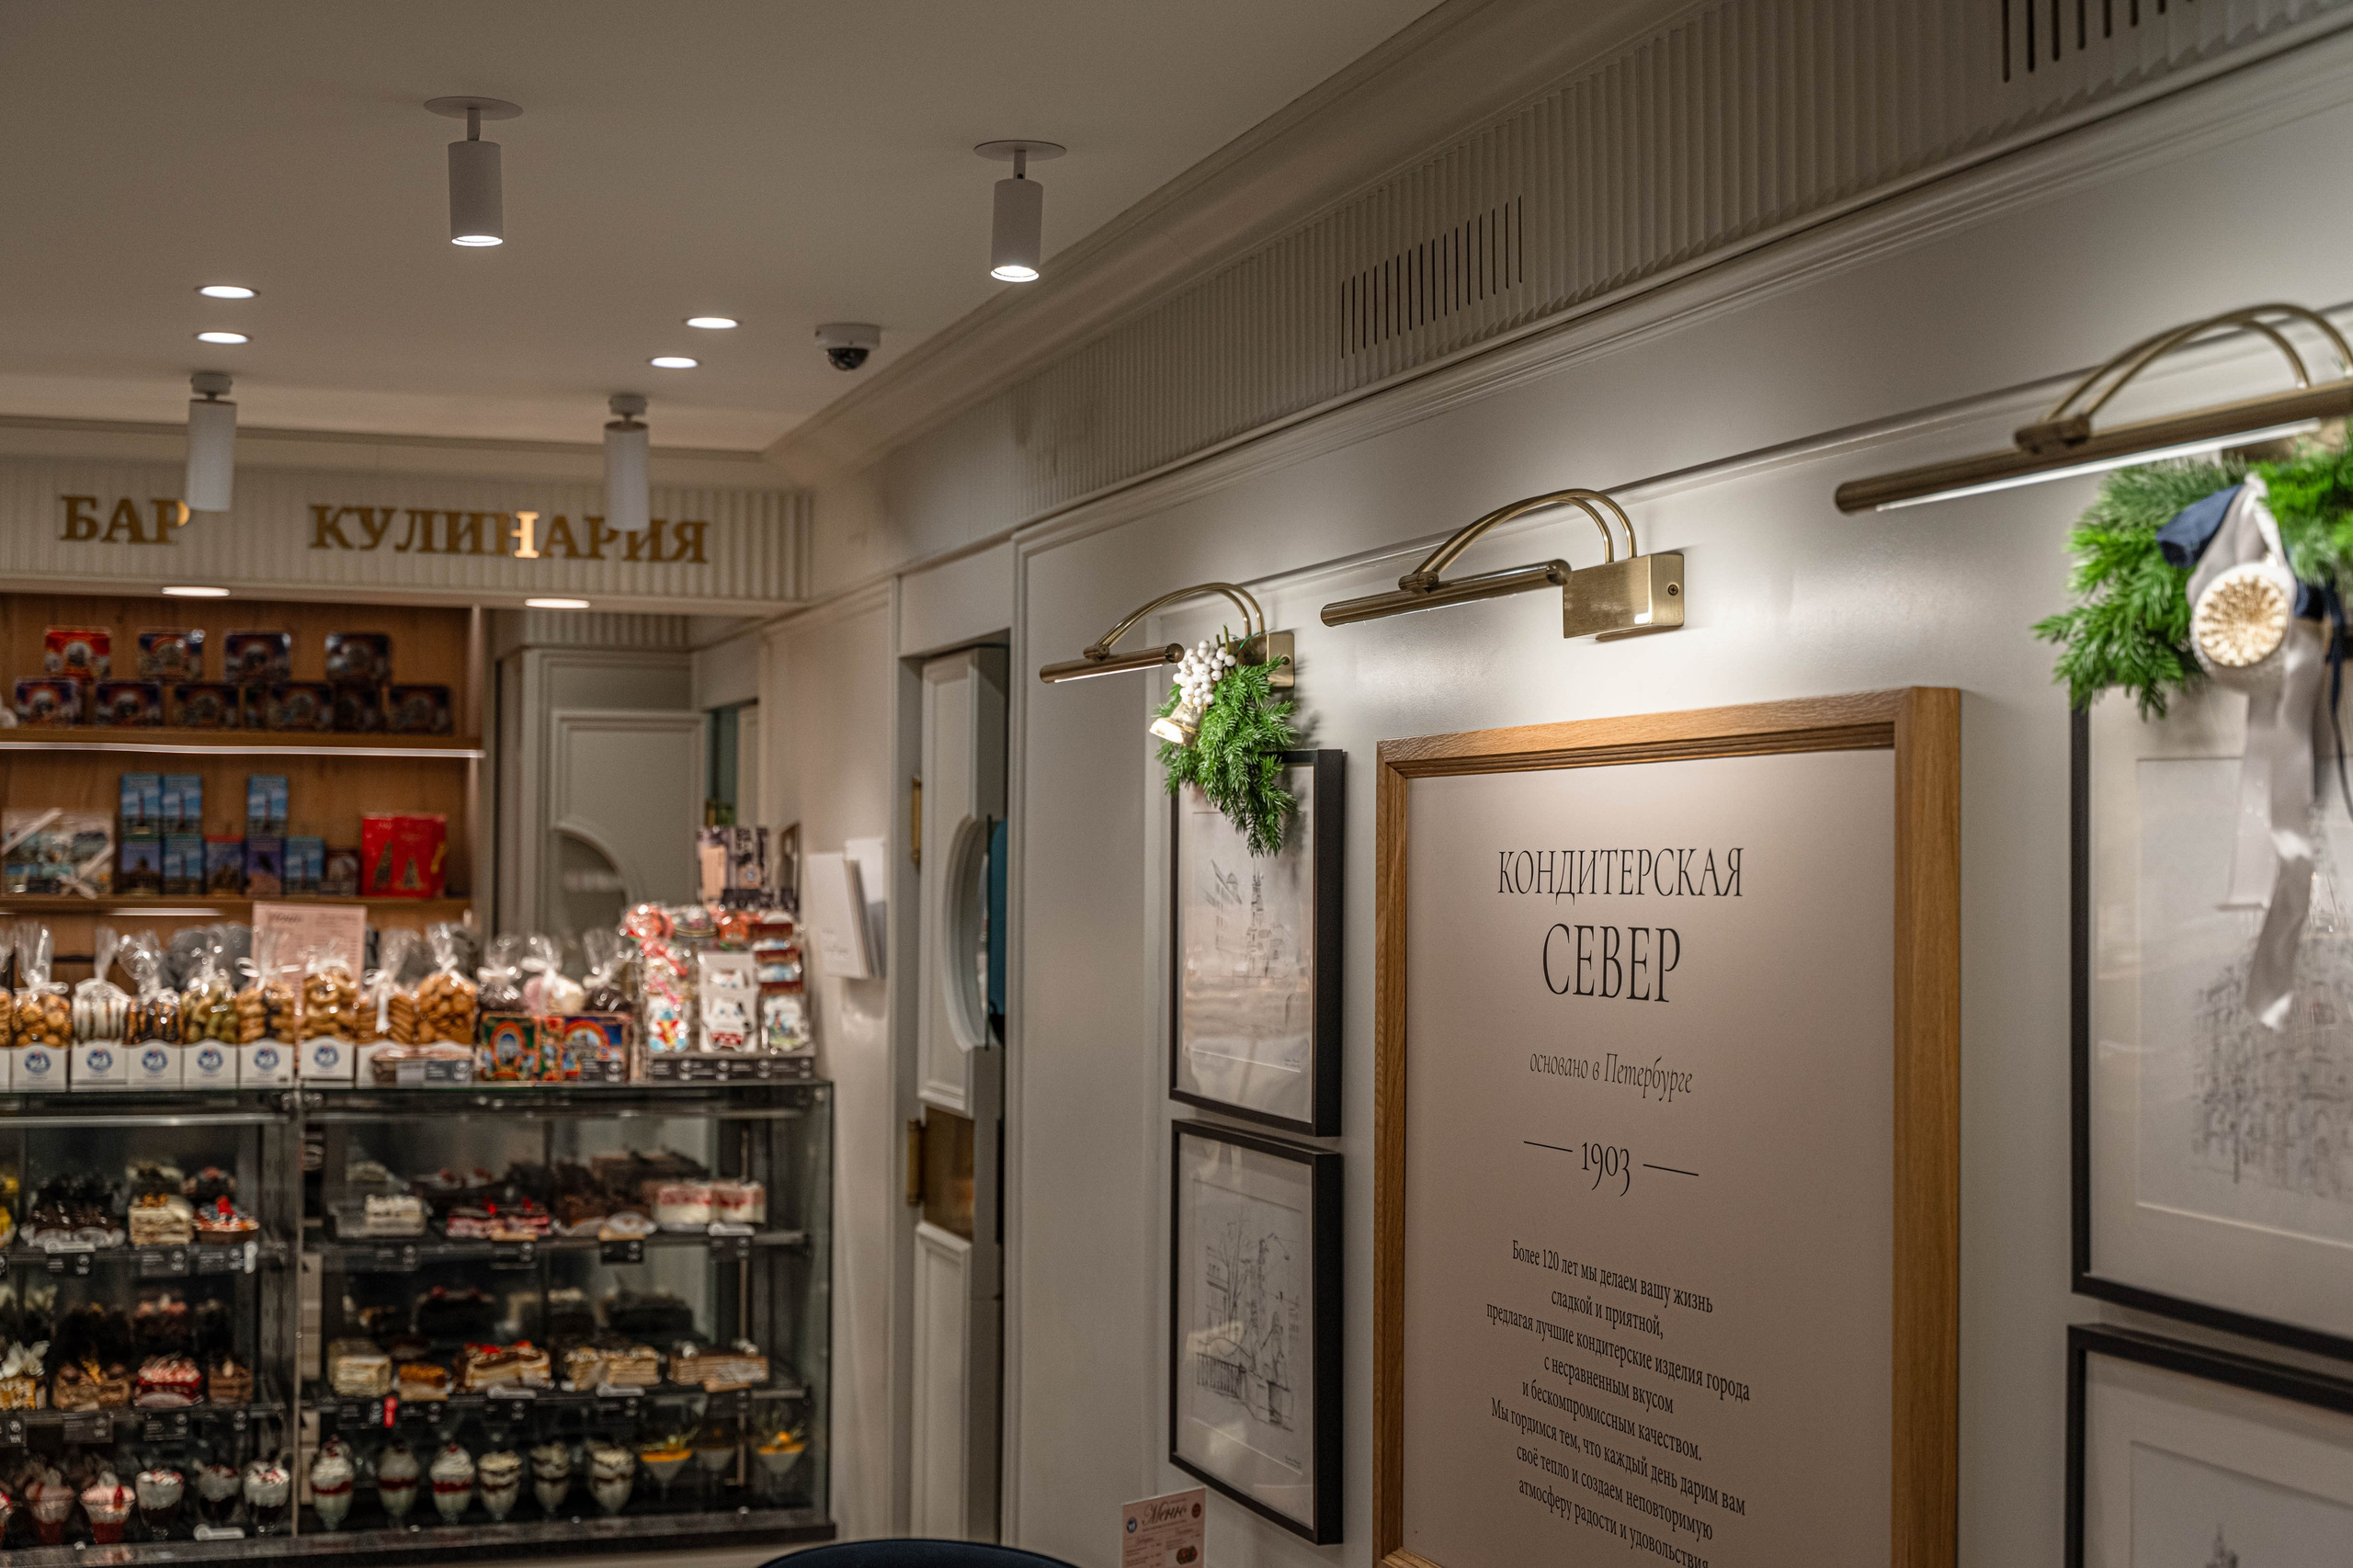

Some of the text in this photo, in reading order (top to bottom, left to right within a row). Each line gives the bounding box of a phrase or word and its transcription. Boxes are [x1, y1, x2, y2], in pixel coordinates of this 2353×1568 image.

[60, 494, 190, 545] БАР
[308, 503, 710, 563] КУЛИНАРИЯ
[1497, 846, 1745, 906] КОНДИТЕРСКАЯ
[1542, 923, 1681, 1004] СЕВЕР
[1529, 1052, 1693, 1103] основано в Петербурге
[1581, 1142, 1631, 1198] 1903
[1512, 1239, 1713, 1313] Более 120 лет мы делаем вашу жизнь
[1551, 1290, 1664, 1340] сладкой и приятной,
[1486, 1303, 1751, 1404] предлагая лучшие кондитерские изделия города
[1543, 1356, 1674, 1415] с несравненным вкусом
[1521, 1379, 1702, 1462] и бескомпромиссным качеством.
[1491, 1396, 1746, 1517] Мы гордимся тем, что каждый день дарим вам
[1516, 1446, 1713, 1543] своё тепло и создаем неповторимую
[1518, 1479, 1573, 1521] атмосферу
[1574, 1503, 1618, 1536] радости
[1619, 1523, 1628, 1540] и
